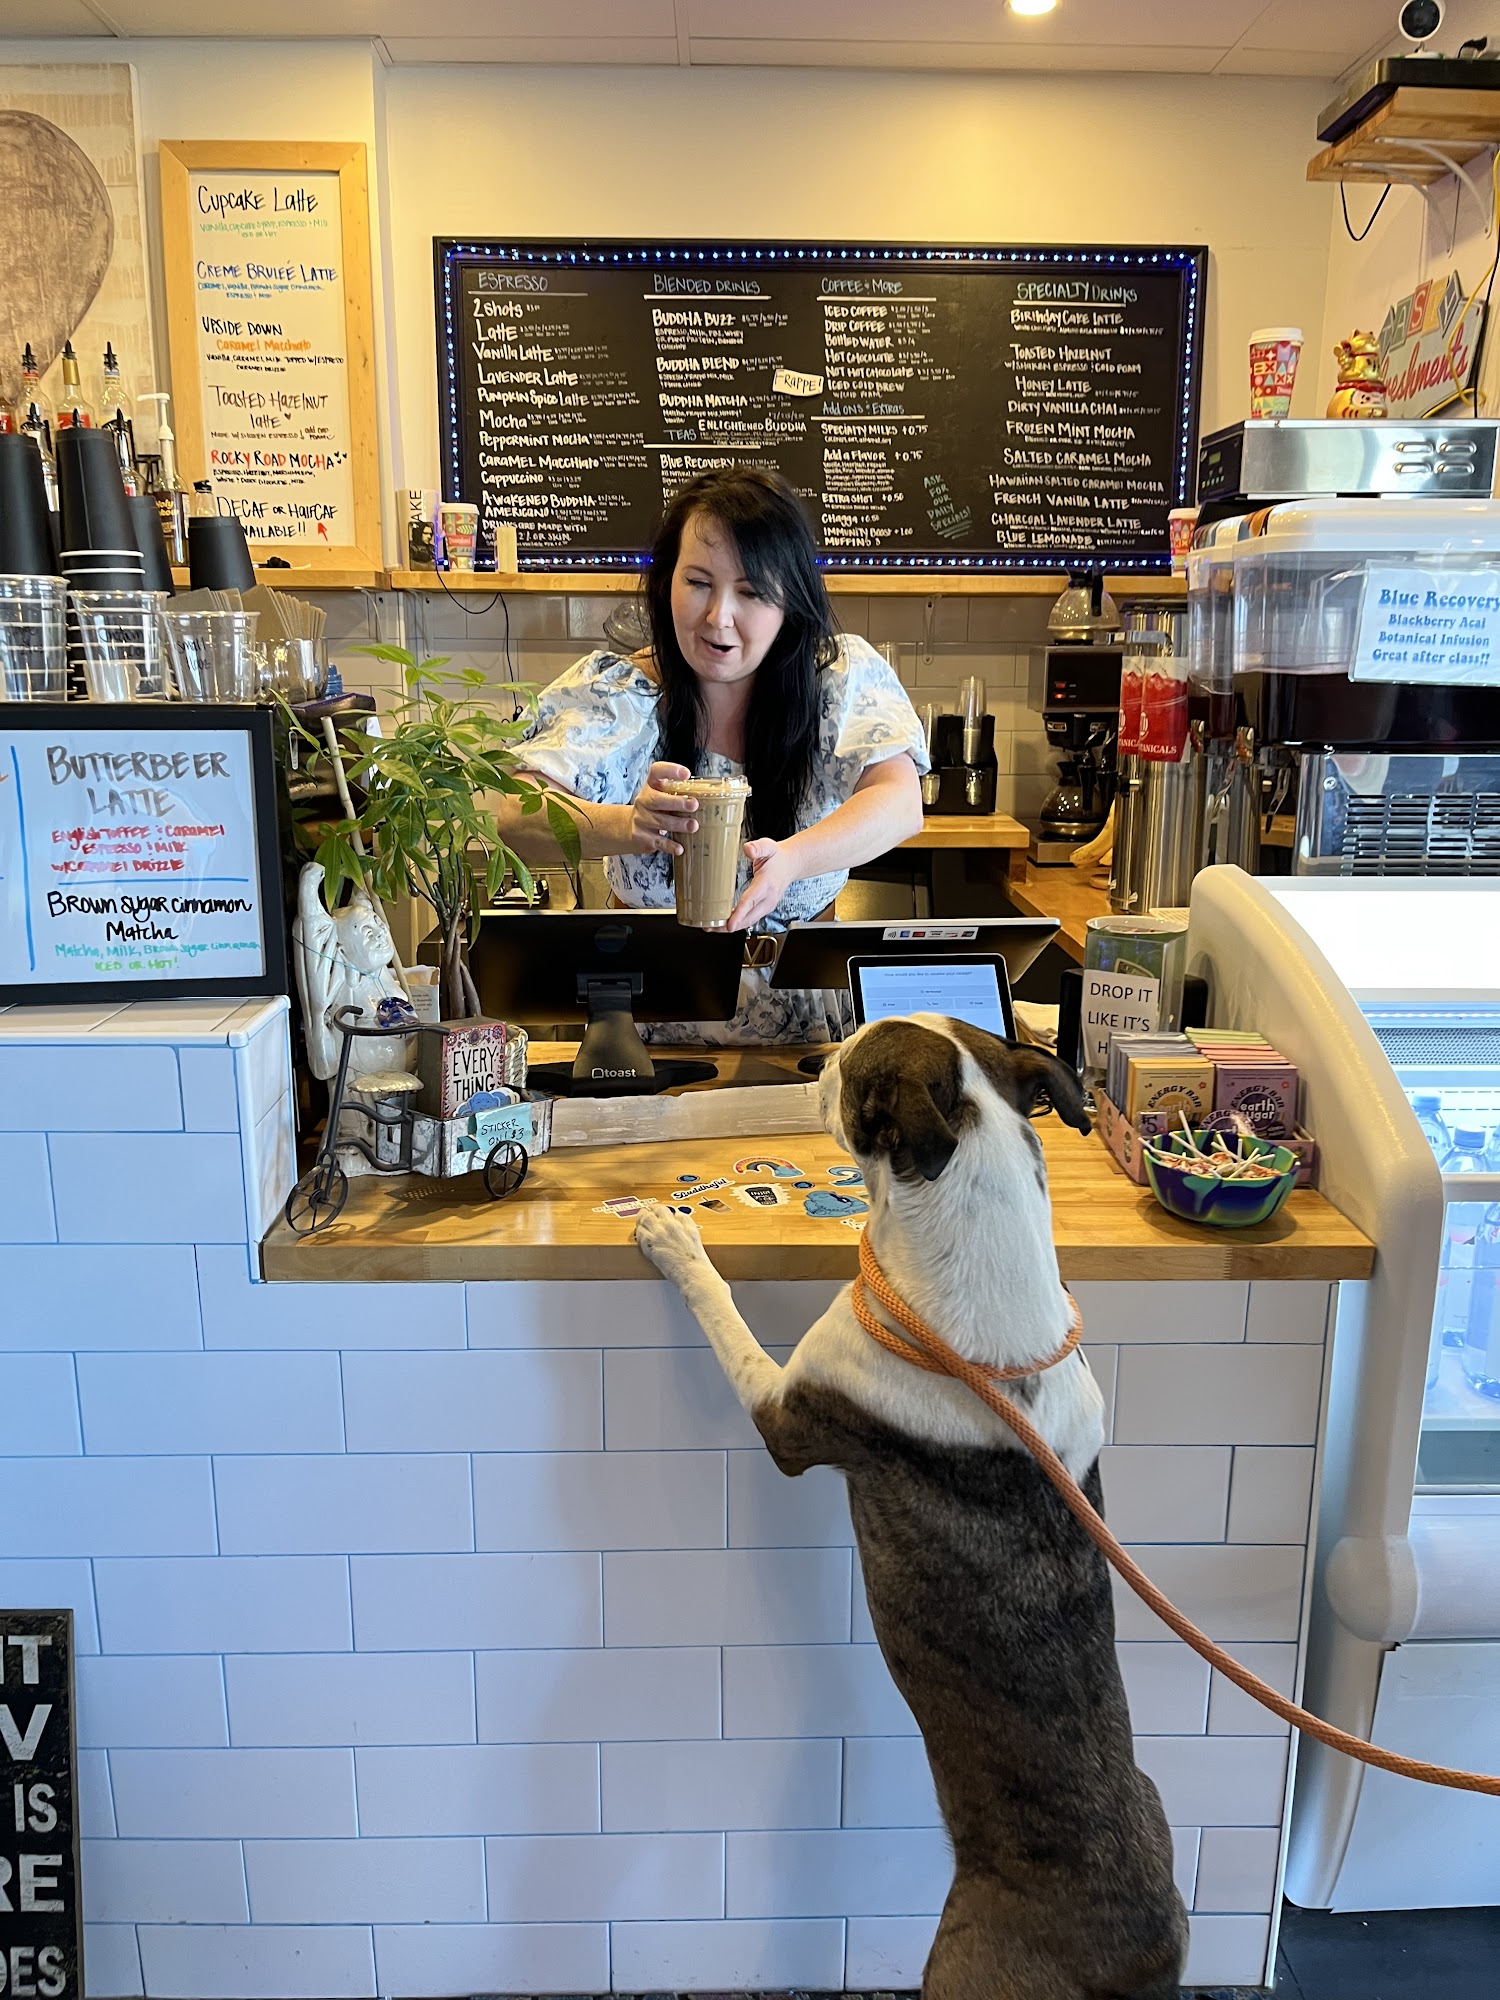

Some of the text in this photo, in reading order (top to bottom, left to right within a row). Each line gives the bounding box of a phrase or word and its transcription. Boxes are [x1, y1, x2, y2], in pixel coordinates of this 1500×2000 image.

[197, 261, 338, 283] CREME LATTE
[478, 271, 549, 292] ESPRESSO
[715, 281, 761, 294] DRINKS
[821, 277, 903, 294] COFFEE MORE
[1017, 282, 1138, 303] SPECIALTY DRINKS
[652, 308, 702, 327] BUDDHA
[703, 312, 736, 327] BUZZ
[824, 305, 888, 317] ICED COFFEE
[1380, 282, 1458, 352] TASTY
[202, 316, 283, 336] UPSIDE DOWN
[824, 319, 886, 334] DRIP COFFEE
[859, 336, 894, 349] WATER
[824, 349, 846, 364] HOT
[1009, 343, 1112, 361] TOASTED HAZELNUT
[656, 356, 700, 372] BUDDHA
[701, 356, 740, 371] BLEND
[1382, 322, 1468, 402] freshments
[825, 366, 846, 378] NOT
[847, 366, 865, 378] HOT
[828, 379, 850, 391] ICED
[876, 382, 905, 392] BREW
[1015, 376, 1092, 393] HONEY LATTE
[659, 393, 748, 408] BUDDHA MATCHA
[1043, 401, 1090, 414] VANILLA
[1090, 402, 1117, 415] CHAI
[479, 409, 528, 430] Mocha
[765, 417, 807, 433] BUDDHA
[663, 429, 697, 441] TEAS
[868, 425, 898, 435] MILKS
[1006, 420, 1055, 436] FROZEN
[1094, 425, 1136, 440] MOCHA
[211, 449, 335, 470] ROCKY ROAD MOCHA
[823, 448, 842, 461] Add
[1003, 447, 1152, 467] SALTED CARAMEL MOCHA
[684, 457, 735, 470] RECOVERY
[923, 474, 944, 488] ASK
[1044, 475, 1080, 488] SALTED
[1126, 480, 1165, 493] MOCHA
[821, 493, 851, 504] EXTRA
[851, 494, 873, 504] SHOT
[928, 483, 949, 498] FOR
[216, 496, 287, 519] DECAF OR
[410, 490, 422, 522] AKE
[933, 495, 951, 506] OUR
[994, 492, 1041, 506] FRENCH
[1094, 496, 1130, 510] LATTE
[927, 502, 954, 519] DAILY
[991, 512, 1142, 530] CHARCOAL LAVENDER LATTE
[823, 527, 868, 540] IMMUNITY
[824, 537, 872, 547] MUFFINS
[996, 530, 1026, 543] BLUE
[1032, 532, 1093, 545] LEMONADE
[1378, 589, 1500, 612] Blue Recovery
[1388, 613, 1486, 630] Blackberry Acai
[1378, 631, 1490, 647] Botanical Infusion
[1372, 648, 1490, 665] Great after class!!
[46, 745, 231, 786] BUTTERBEER
[87, 787, 177, 817] LATTE
[82, 842, 142, 855] ESPRESSO
[132, 859, 185, 872] DRIZZLE
[47, 891, 118, 917] Brown
[171, 895, 252, 915] cinnamon
[106, 920, 179, 941] Matcha
[55, 943, 104, 959] Matcha,
[95, 961, 123, 971] ICED
[128, 960, 146, 970] OR
[1090, 982, 1153, 1003] DROP IT
[1088, 1010, 1150, 1032] LIKE IT'S
[453, 1044, 498, 1077] EVERY
[604, 1068, 637, 1078] toast
[1148, 1085, 1202, 1108] ENERGY BAR
[1231, 1085, 1270, 1108] ENERGY
[1240, 1097, 1275, 1111] earth
[1246, 1111, 1275, 1122] ugar
[481, 1118, 520, 1136] STICKER
[510, 1127, 524, 1141] $3
[14, 1783, 57, 1834] IS
